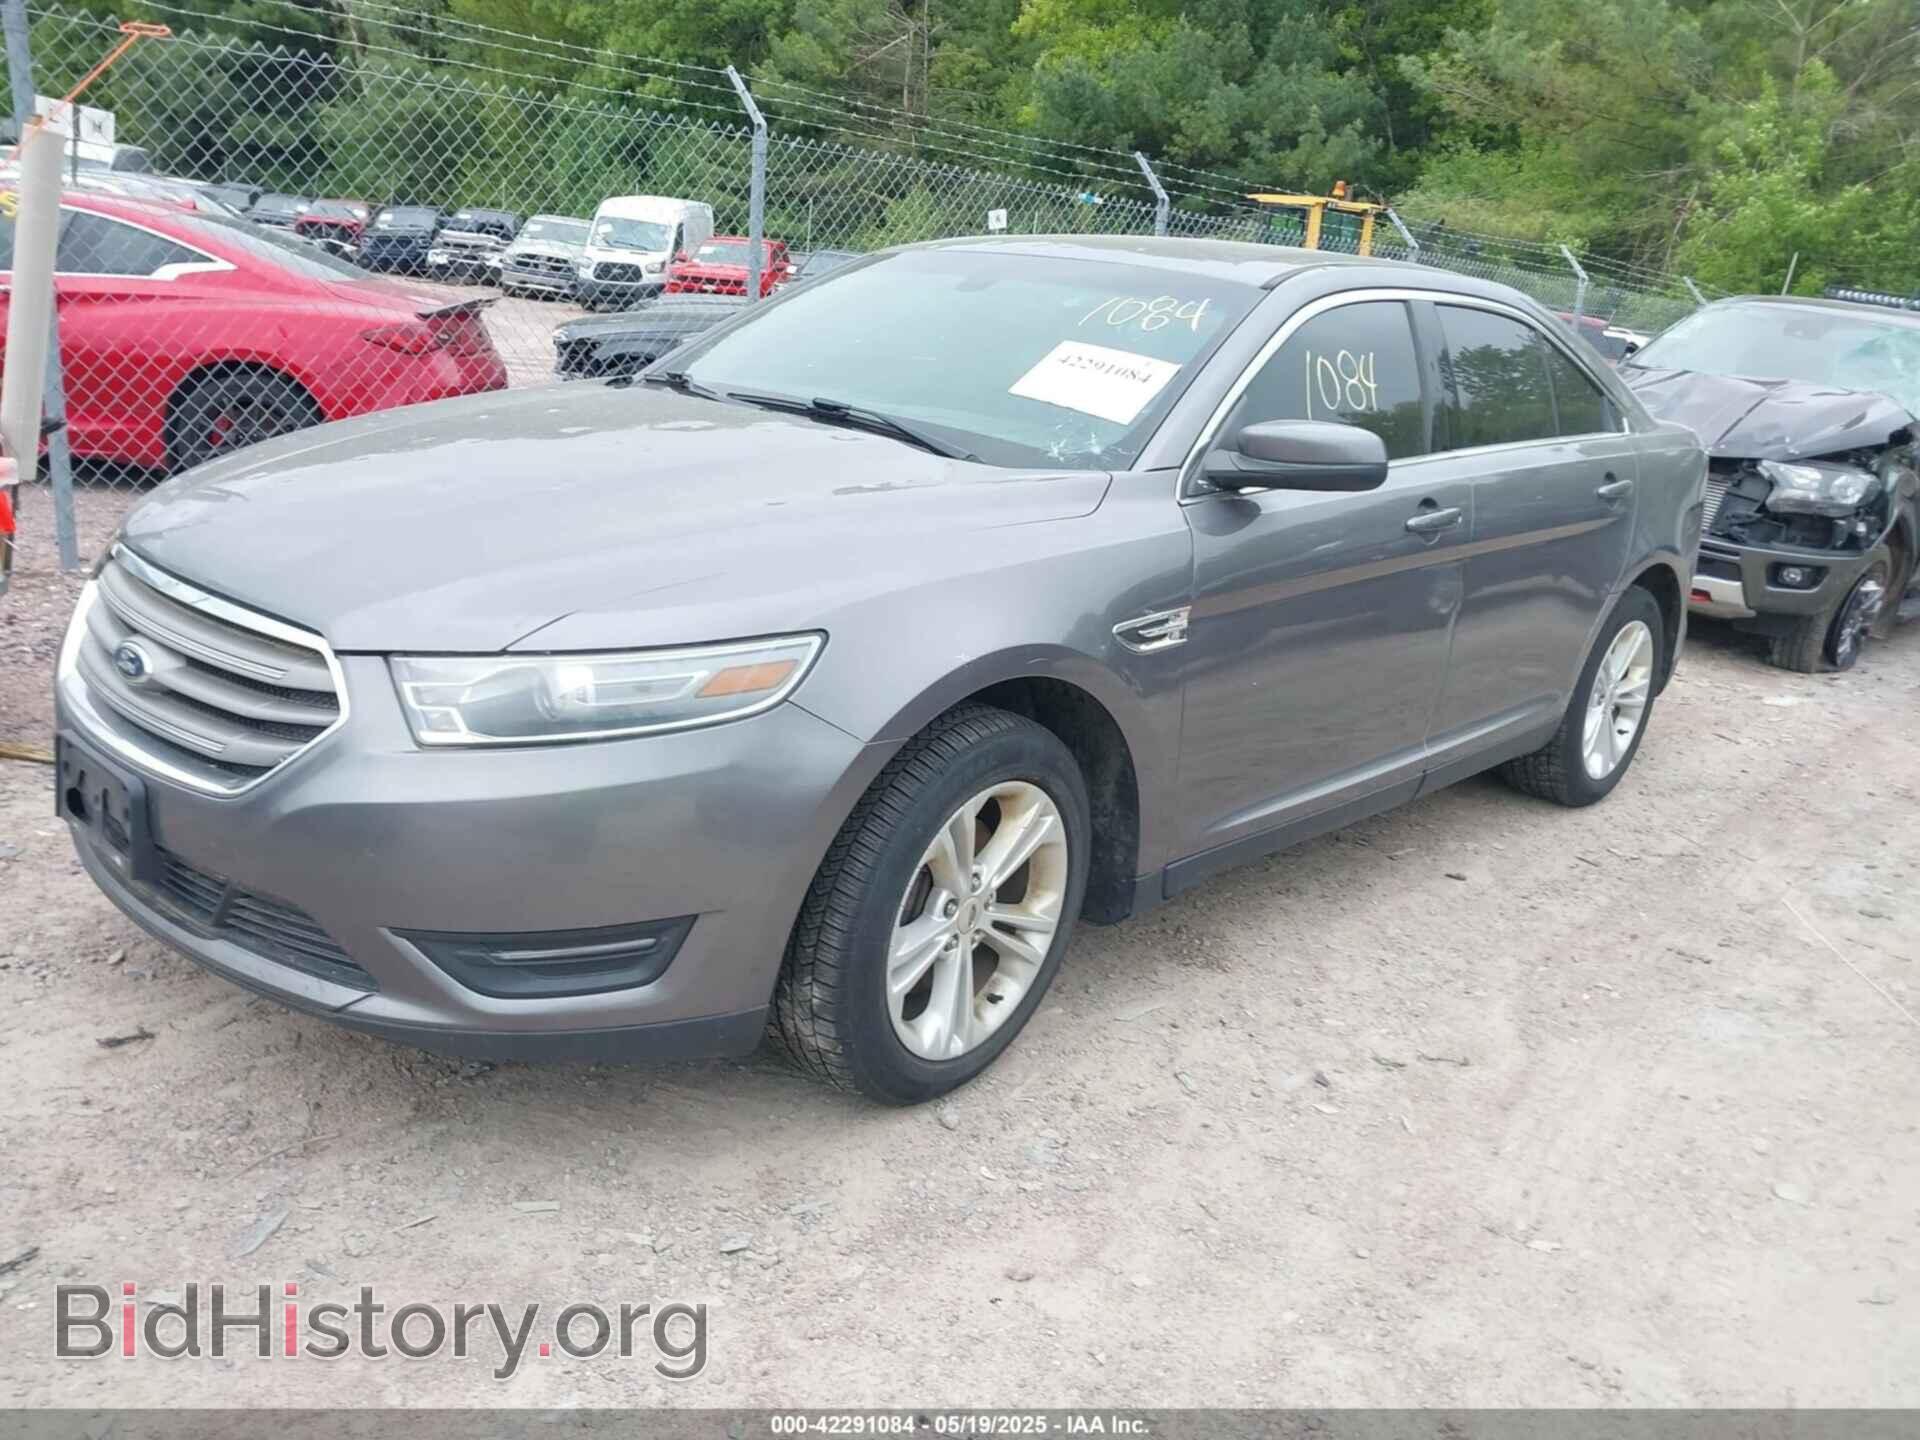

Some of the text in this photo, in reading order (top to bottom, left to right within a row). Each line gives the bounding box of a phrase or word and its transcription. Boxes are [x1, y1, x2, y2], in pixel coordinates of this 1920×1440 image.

[1077, 295, 1212, 332] 1084
[1057, 354, 1153, 384] 42291084
[1305, 349, 1378, 423] 1084
